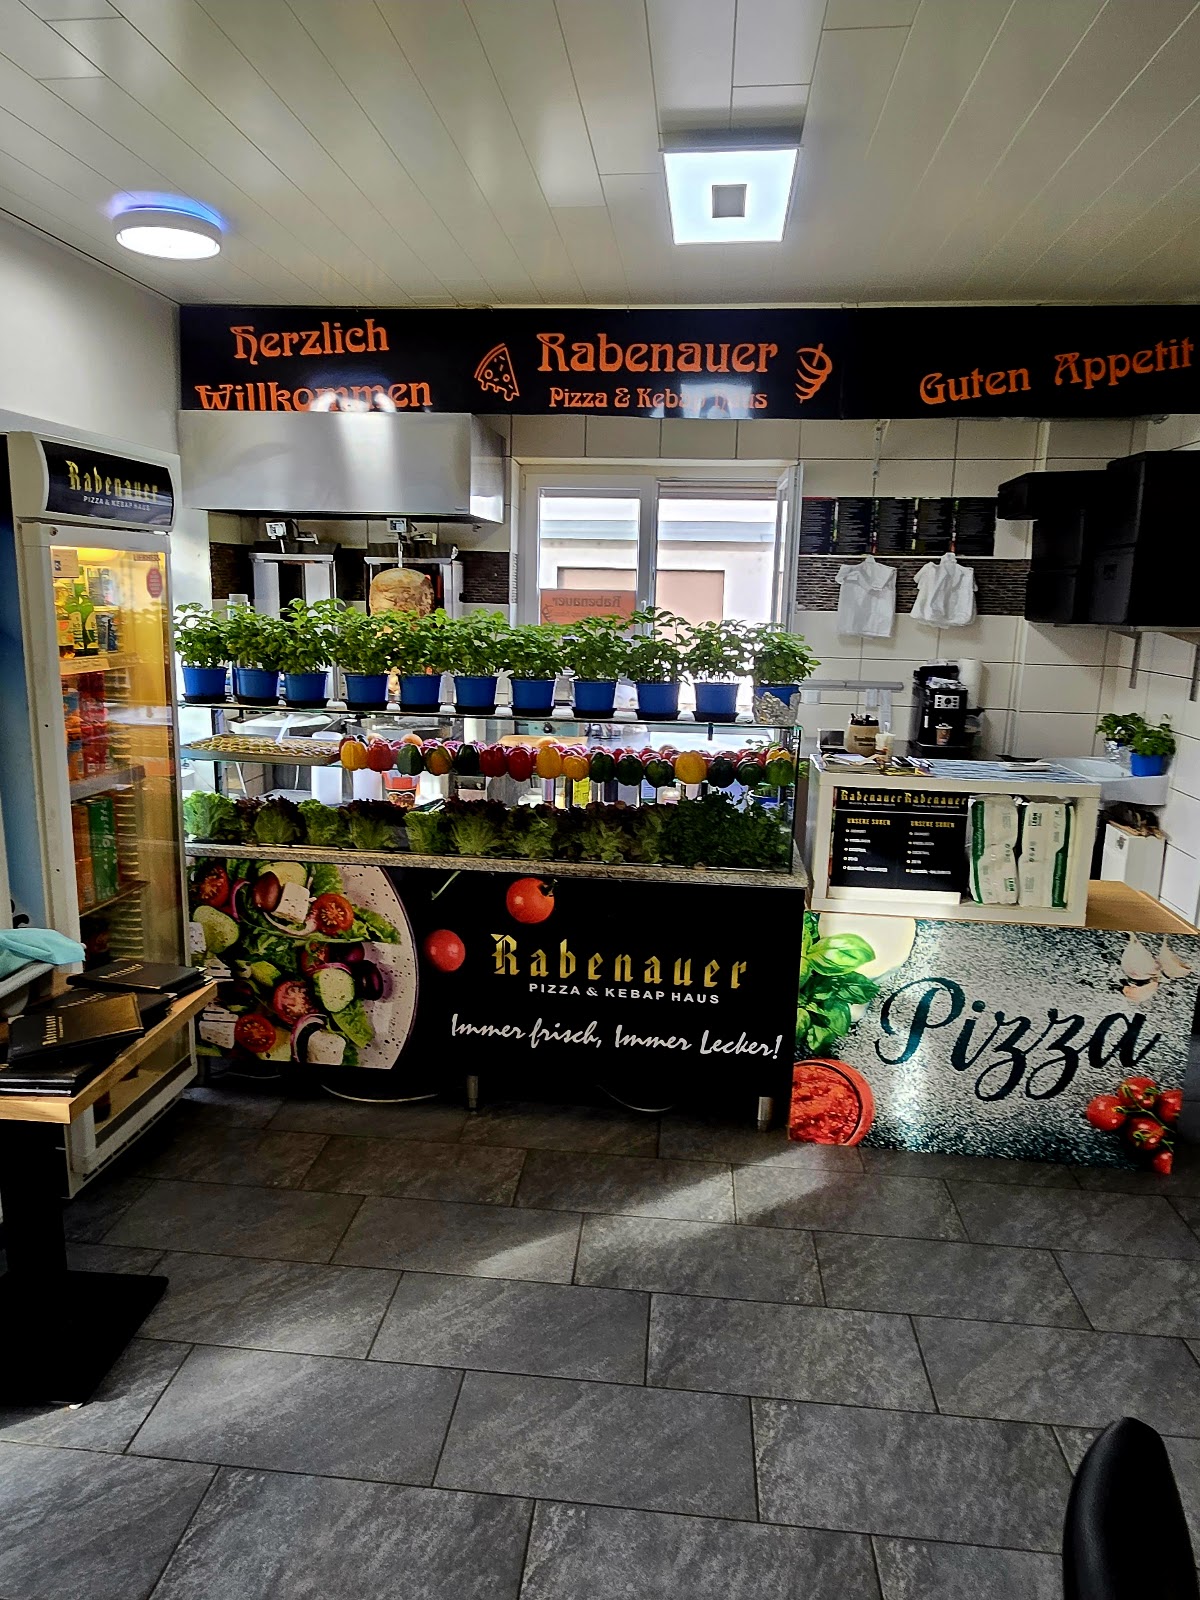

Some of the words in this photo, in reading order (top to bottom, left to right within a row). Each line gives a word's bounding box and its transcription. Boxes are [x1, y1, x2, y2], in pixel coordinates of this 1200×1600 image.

[230, 318, 390, 365] Herzlich
[536, 332, 779, 373] Rabenauer
[919, 368, 1031, 405] Guten
[1054, 336, 1194, 390] Appetit
[549, 387, 608, 408] Pizza
[614, 388, 630, 408] &
[713, 389, 768, 413] Hus
[65, 460, 158, 502] Rabenauer
[83, 495, 103, 505] PIZZA
[491, 933, 747, 989] Rabenauer
[529, 983, 581, 995] PIZZA
[586, 986, 599, 997] &
[605, 988, 665, 1001] KEBAP
[671, 992, 720, 1004] HAUS
[451, 1013, 526, 1039] Immer
[529, 1017, 602, 1049] frisch,
[614, 1024, 692, 1051] Immer
[699, 1029, 783, 1060] Lecker!
[874, 976, 1163, 1102] Pizza
